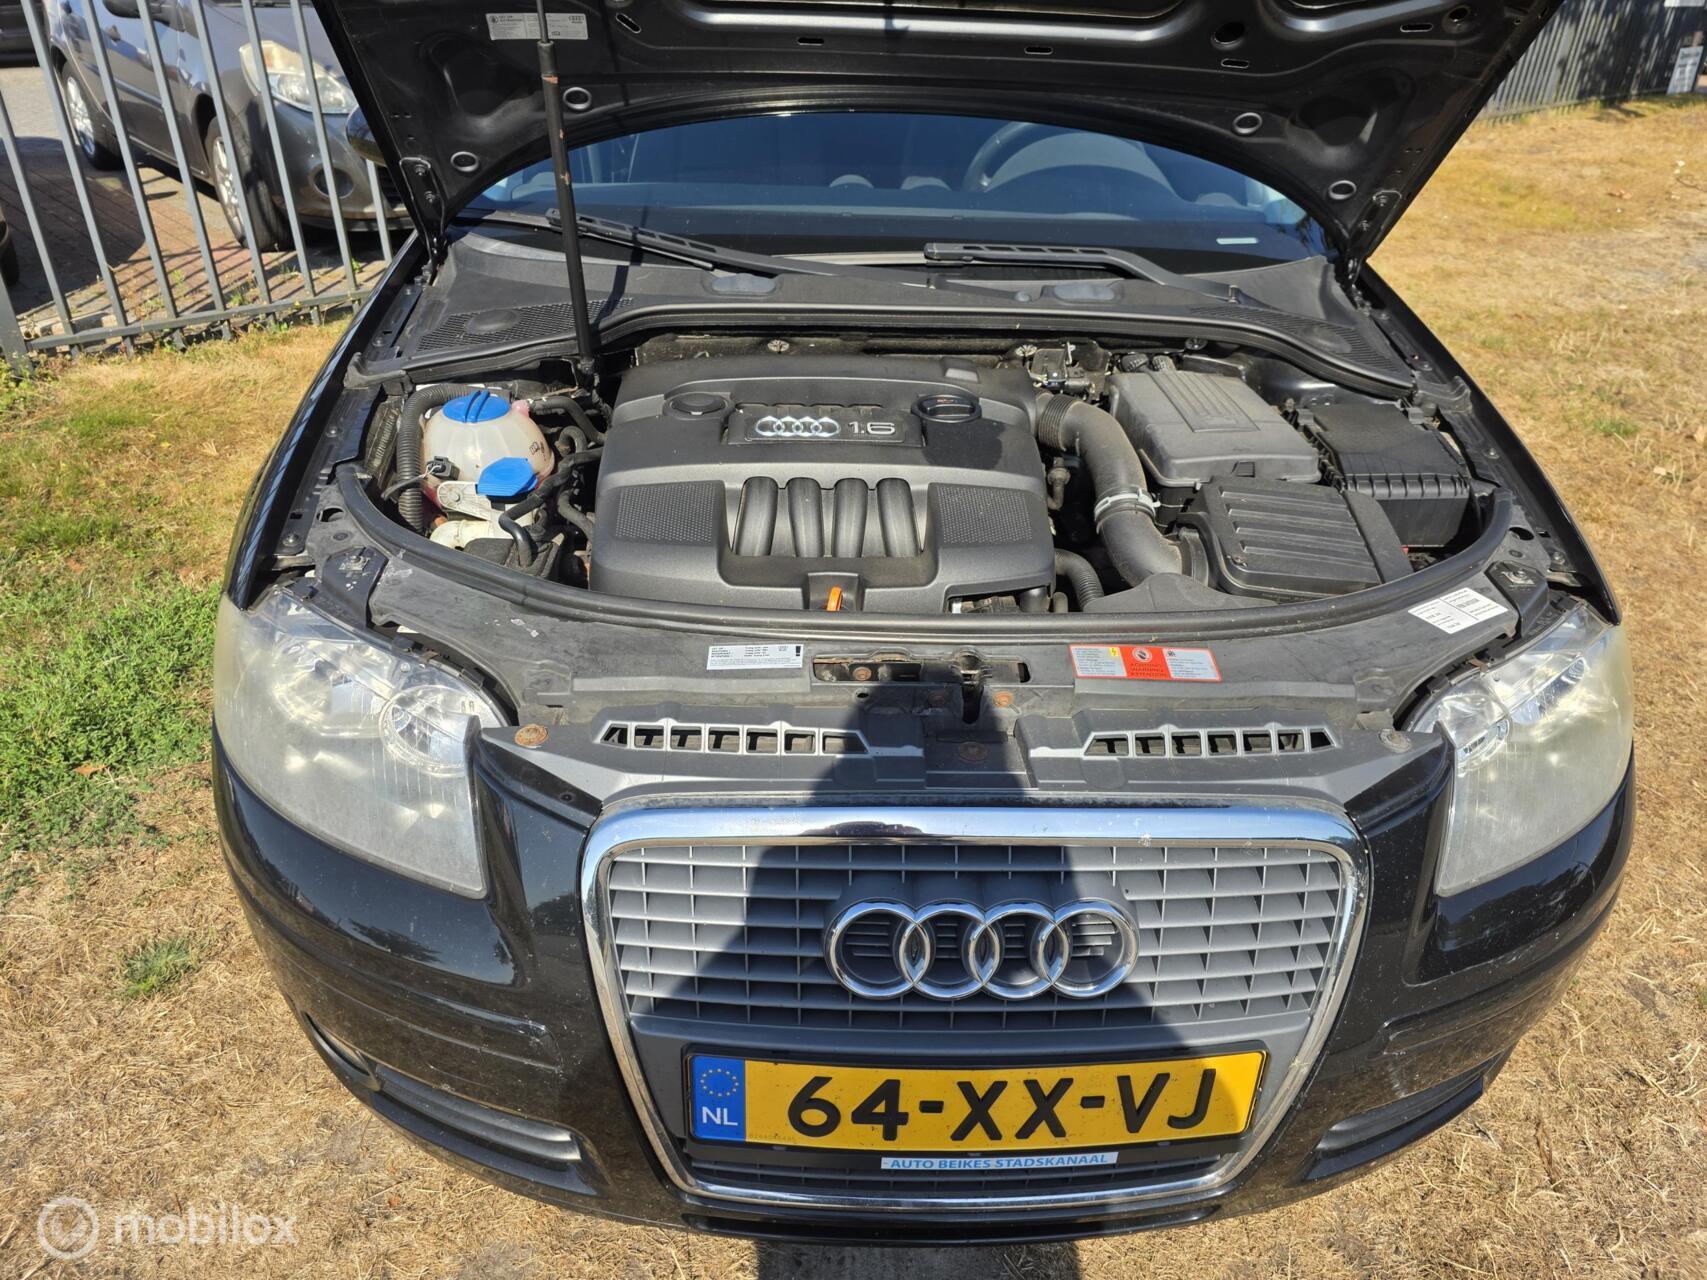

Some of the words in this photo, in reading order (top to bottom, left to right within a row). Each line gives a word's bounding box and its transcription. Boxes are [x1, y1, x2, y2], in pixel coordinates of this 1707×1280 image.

[849, 421, 896, 435] 1.6
[787, 1068, 1216, 1141] 64-XX-VJ
[702, 1106, 738, 1126] NL
[891, 1159, 934, 1169] AUTO
[938, 1159, 991, 1169] BEIKES
[994, 1155, 1108, 1168] STADSKANAAL
